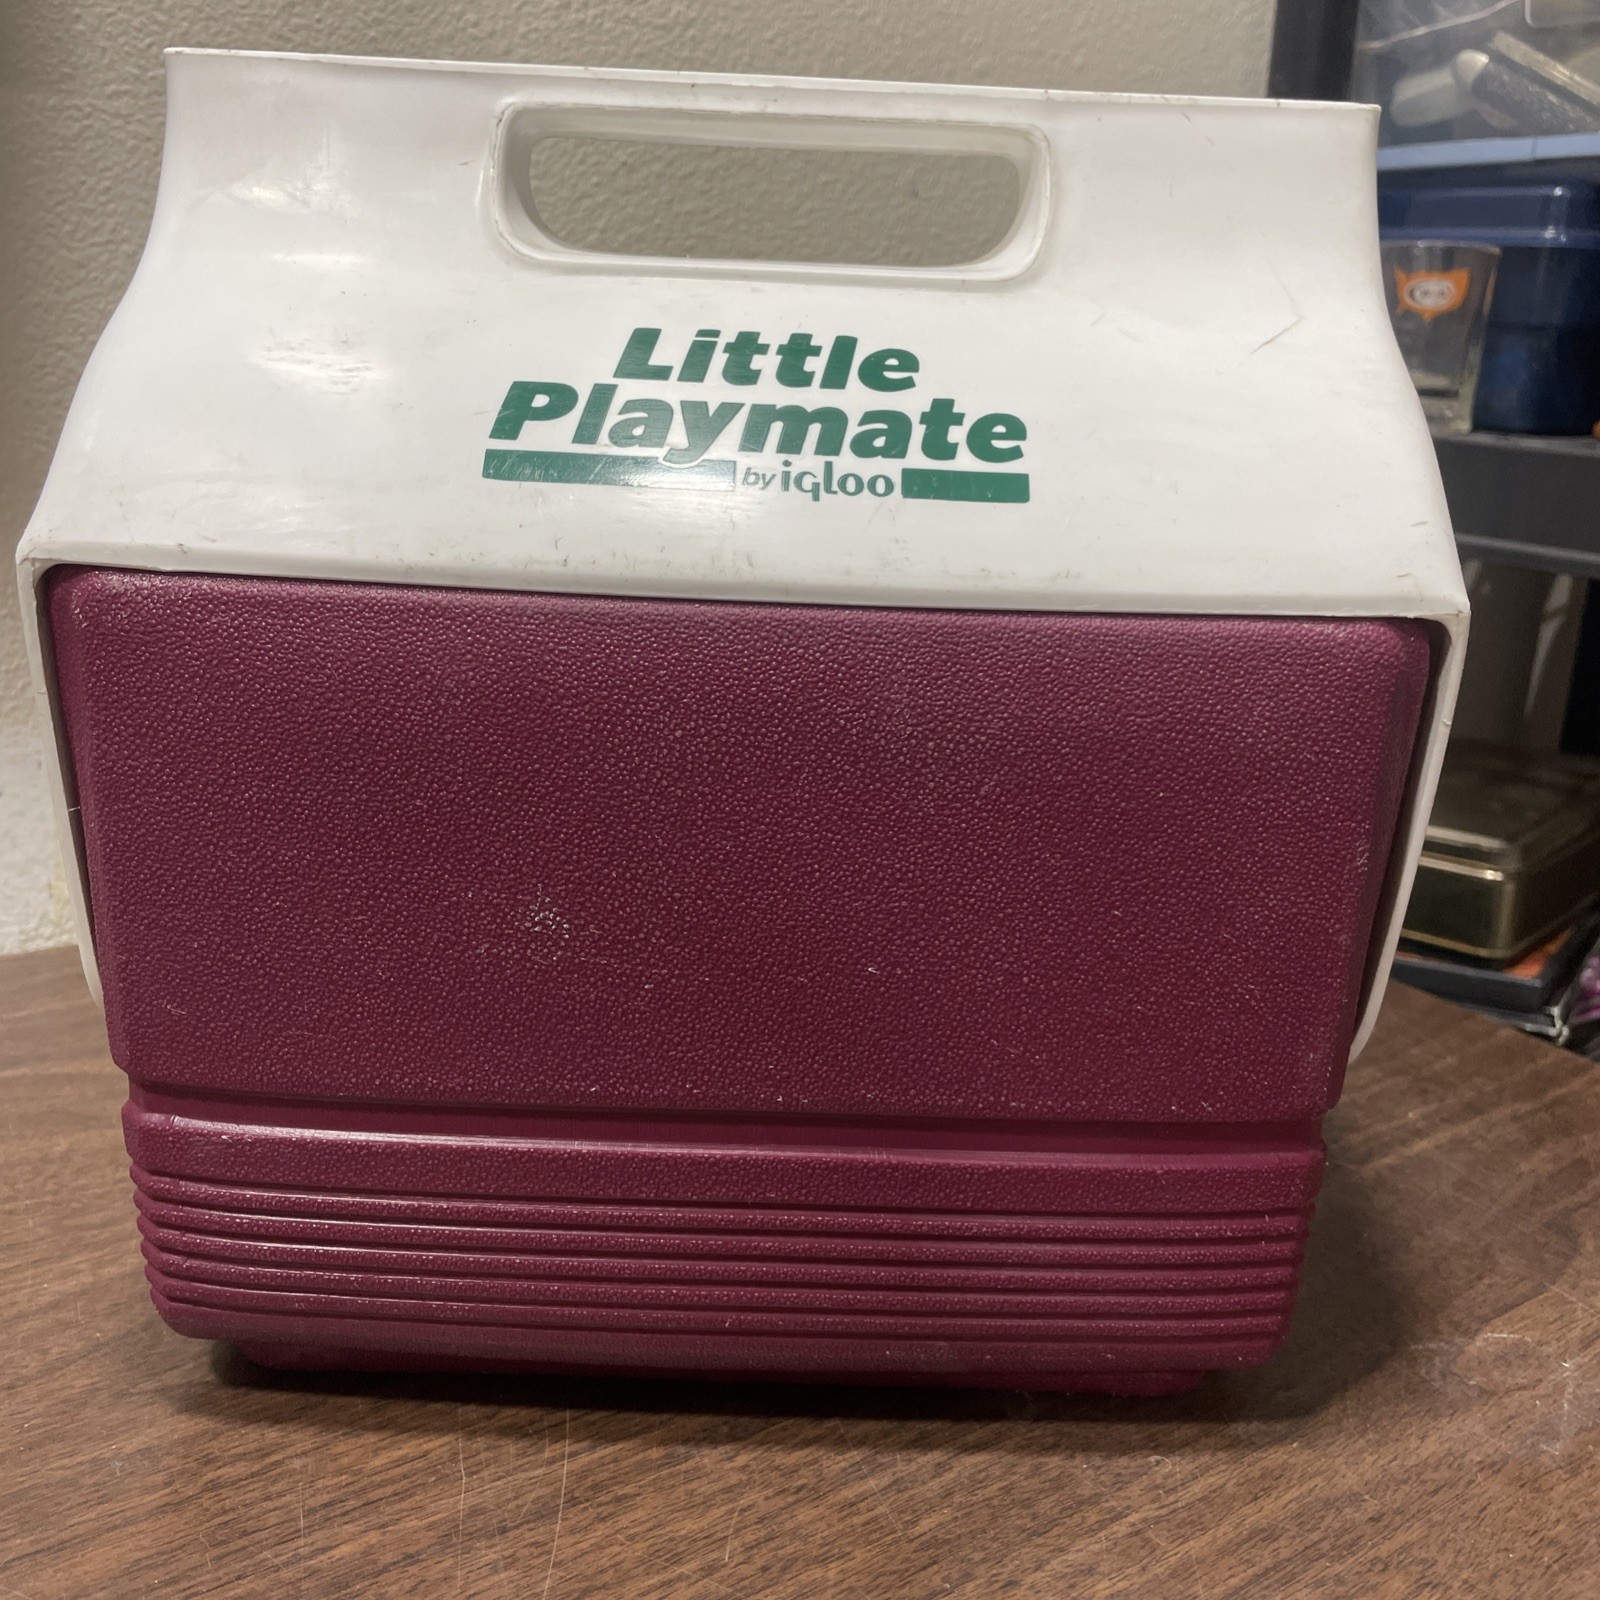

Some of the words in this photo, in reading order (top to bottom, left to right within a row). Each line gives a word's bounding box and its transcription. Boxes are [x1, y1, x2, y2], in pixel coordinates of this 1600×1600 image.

[613, 328, 920, 393] Little
[488, 380, 1028, 464] Playmate
[742, 467, 776, 490] by
